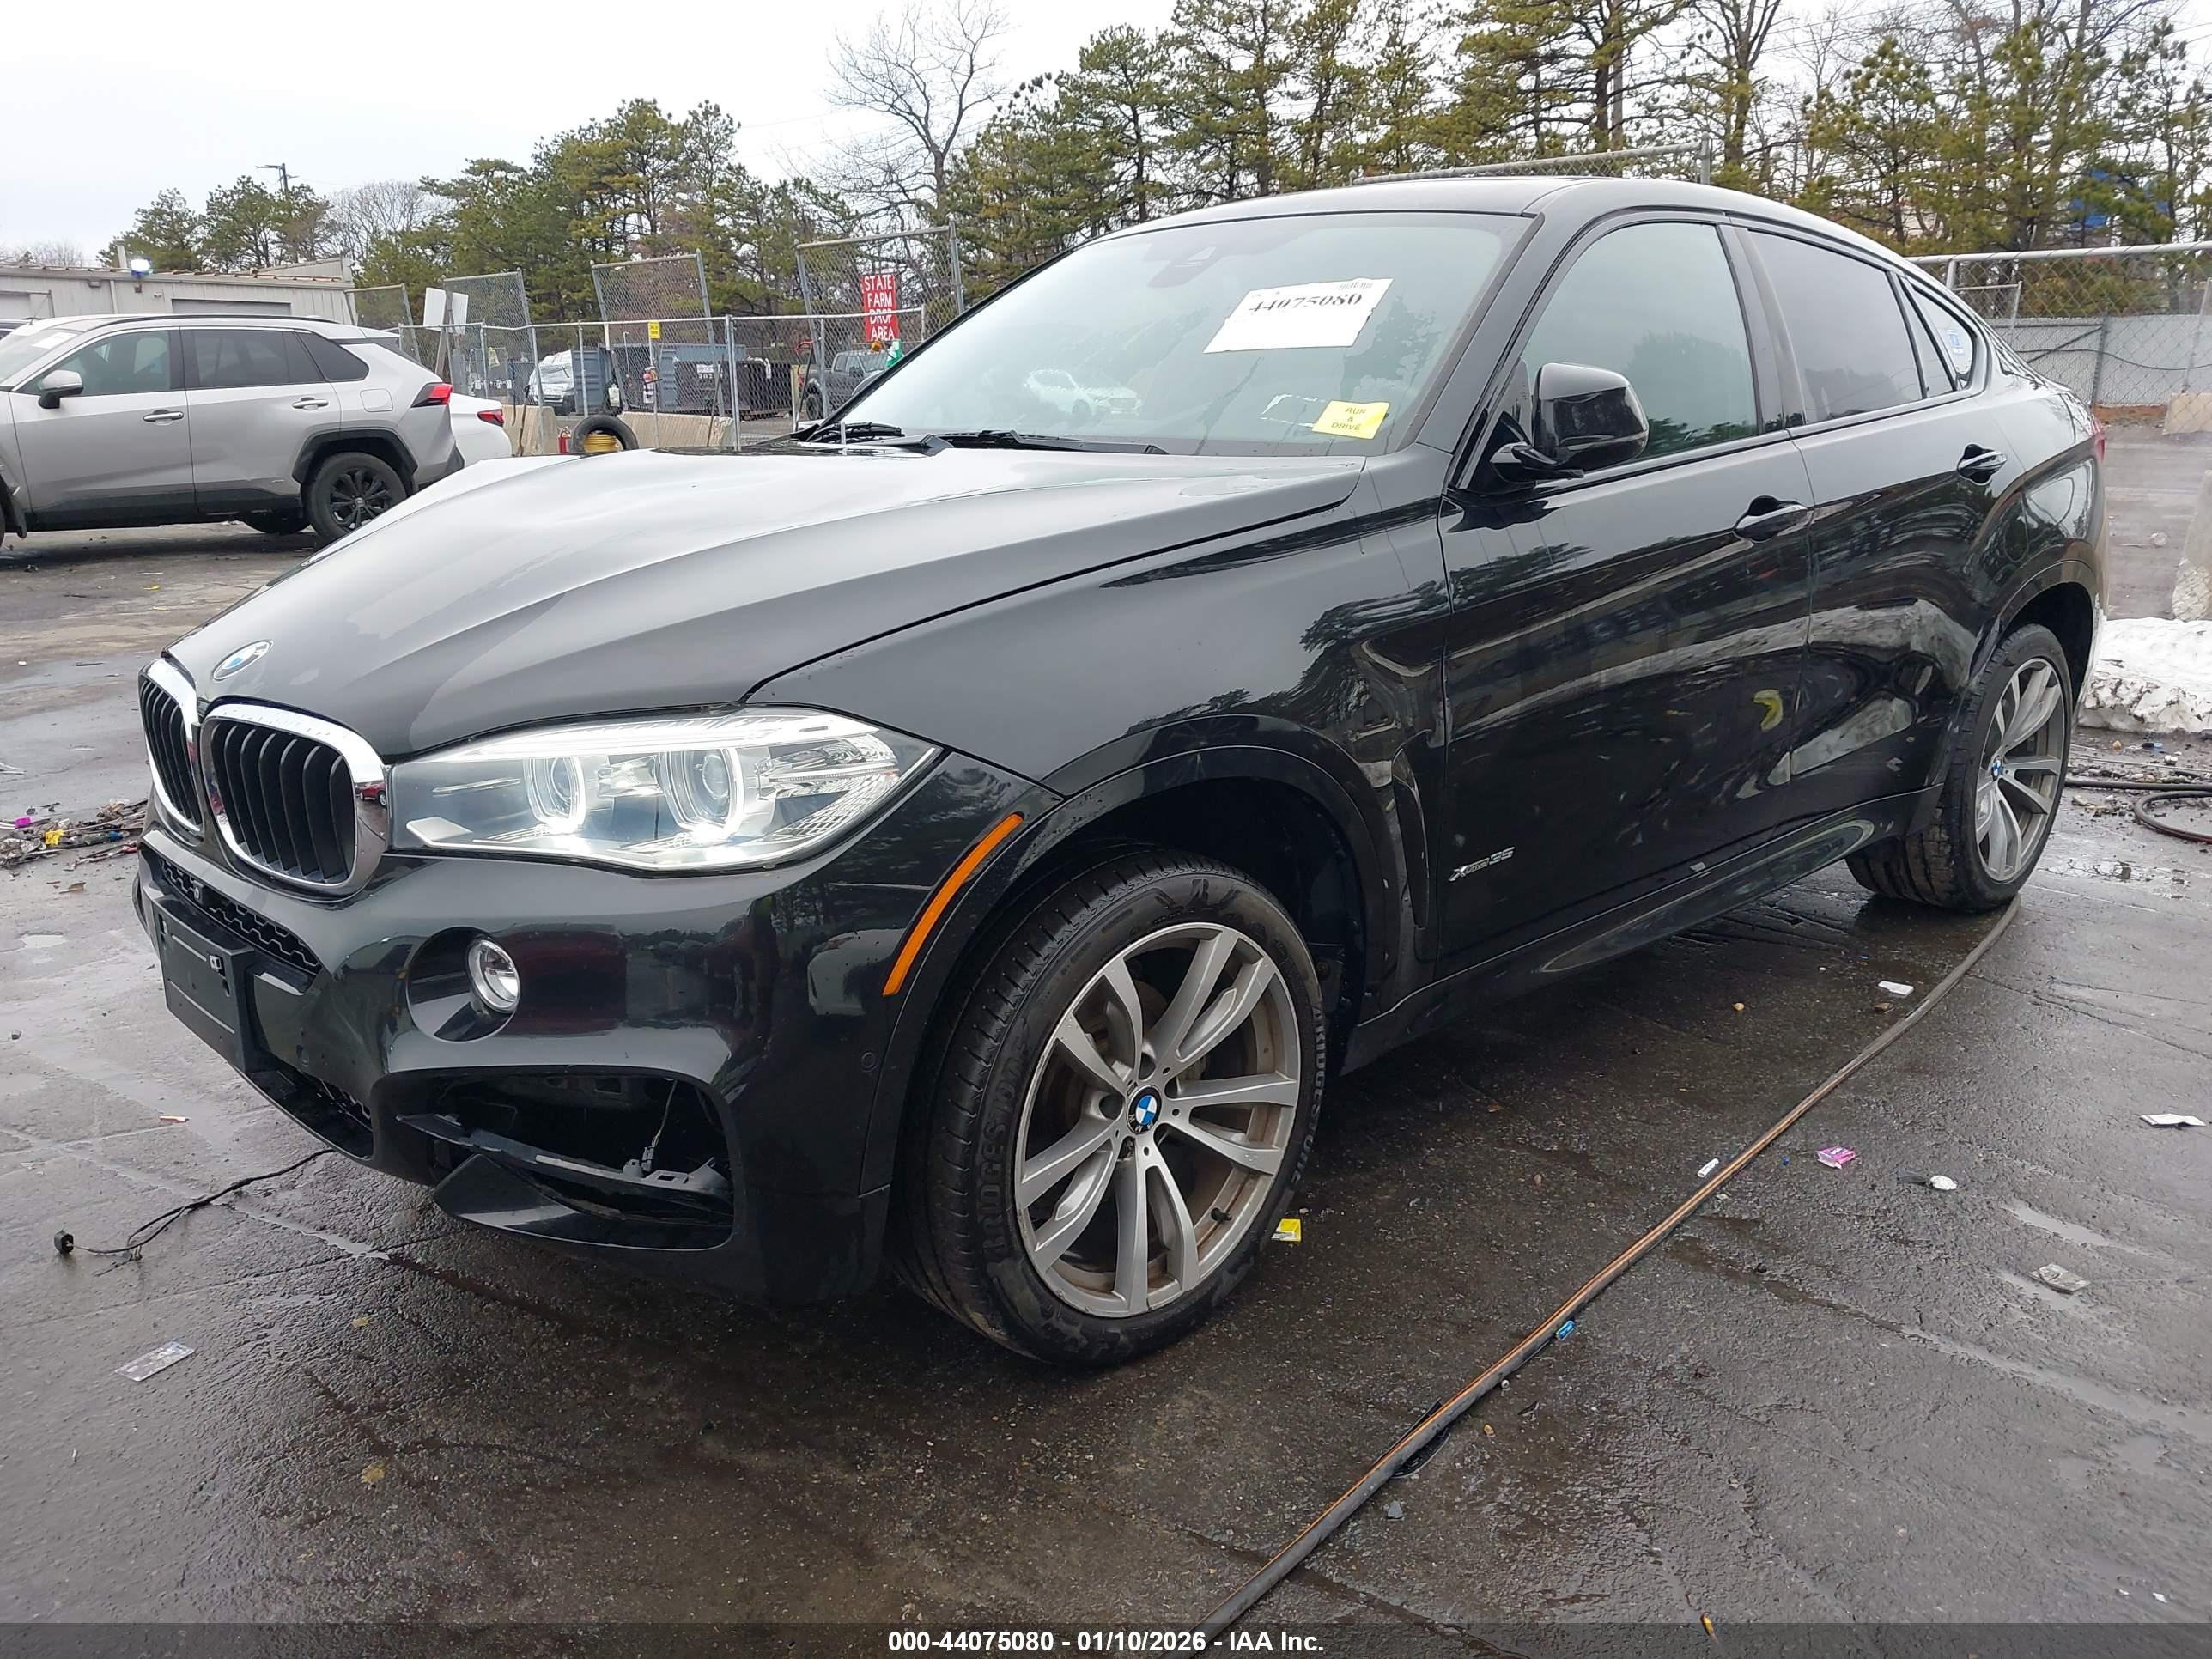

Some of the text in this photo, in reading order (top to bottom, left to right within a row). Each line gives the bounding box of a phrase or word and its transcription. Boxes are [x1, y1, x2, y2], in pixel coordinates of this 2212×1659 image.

[864, 274, 893, 292] STATE
[867, 290, 893, 308] FARM
[1249, 293, 1363, 313] 44075080
[869, 307, 893, 325] DROP
[870, 325, 895, 342] AREA
[1331, 422, 1362, 431] DRIVE
